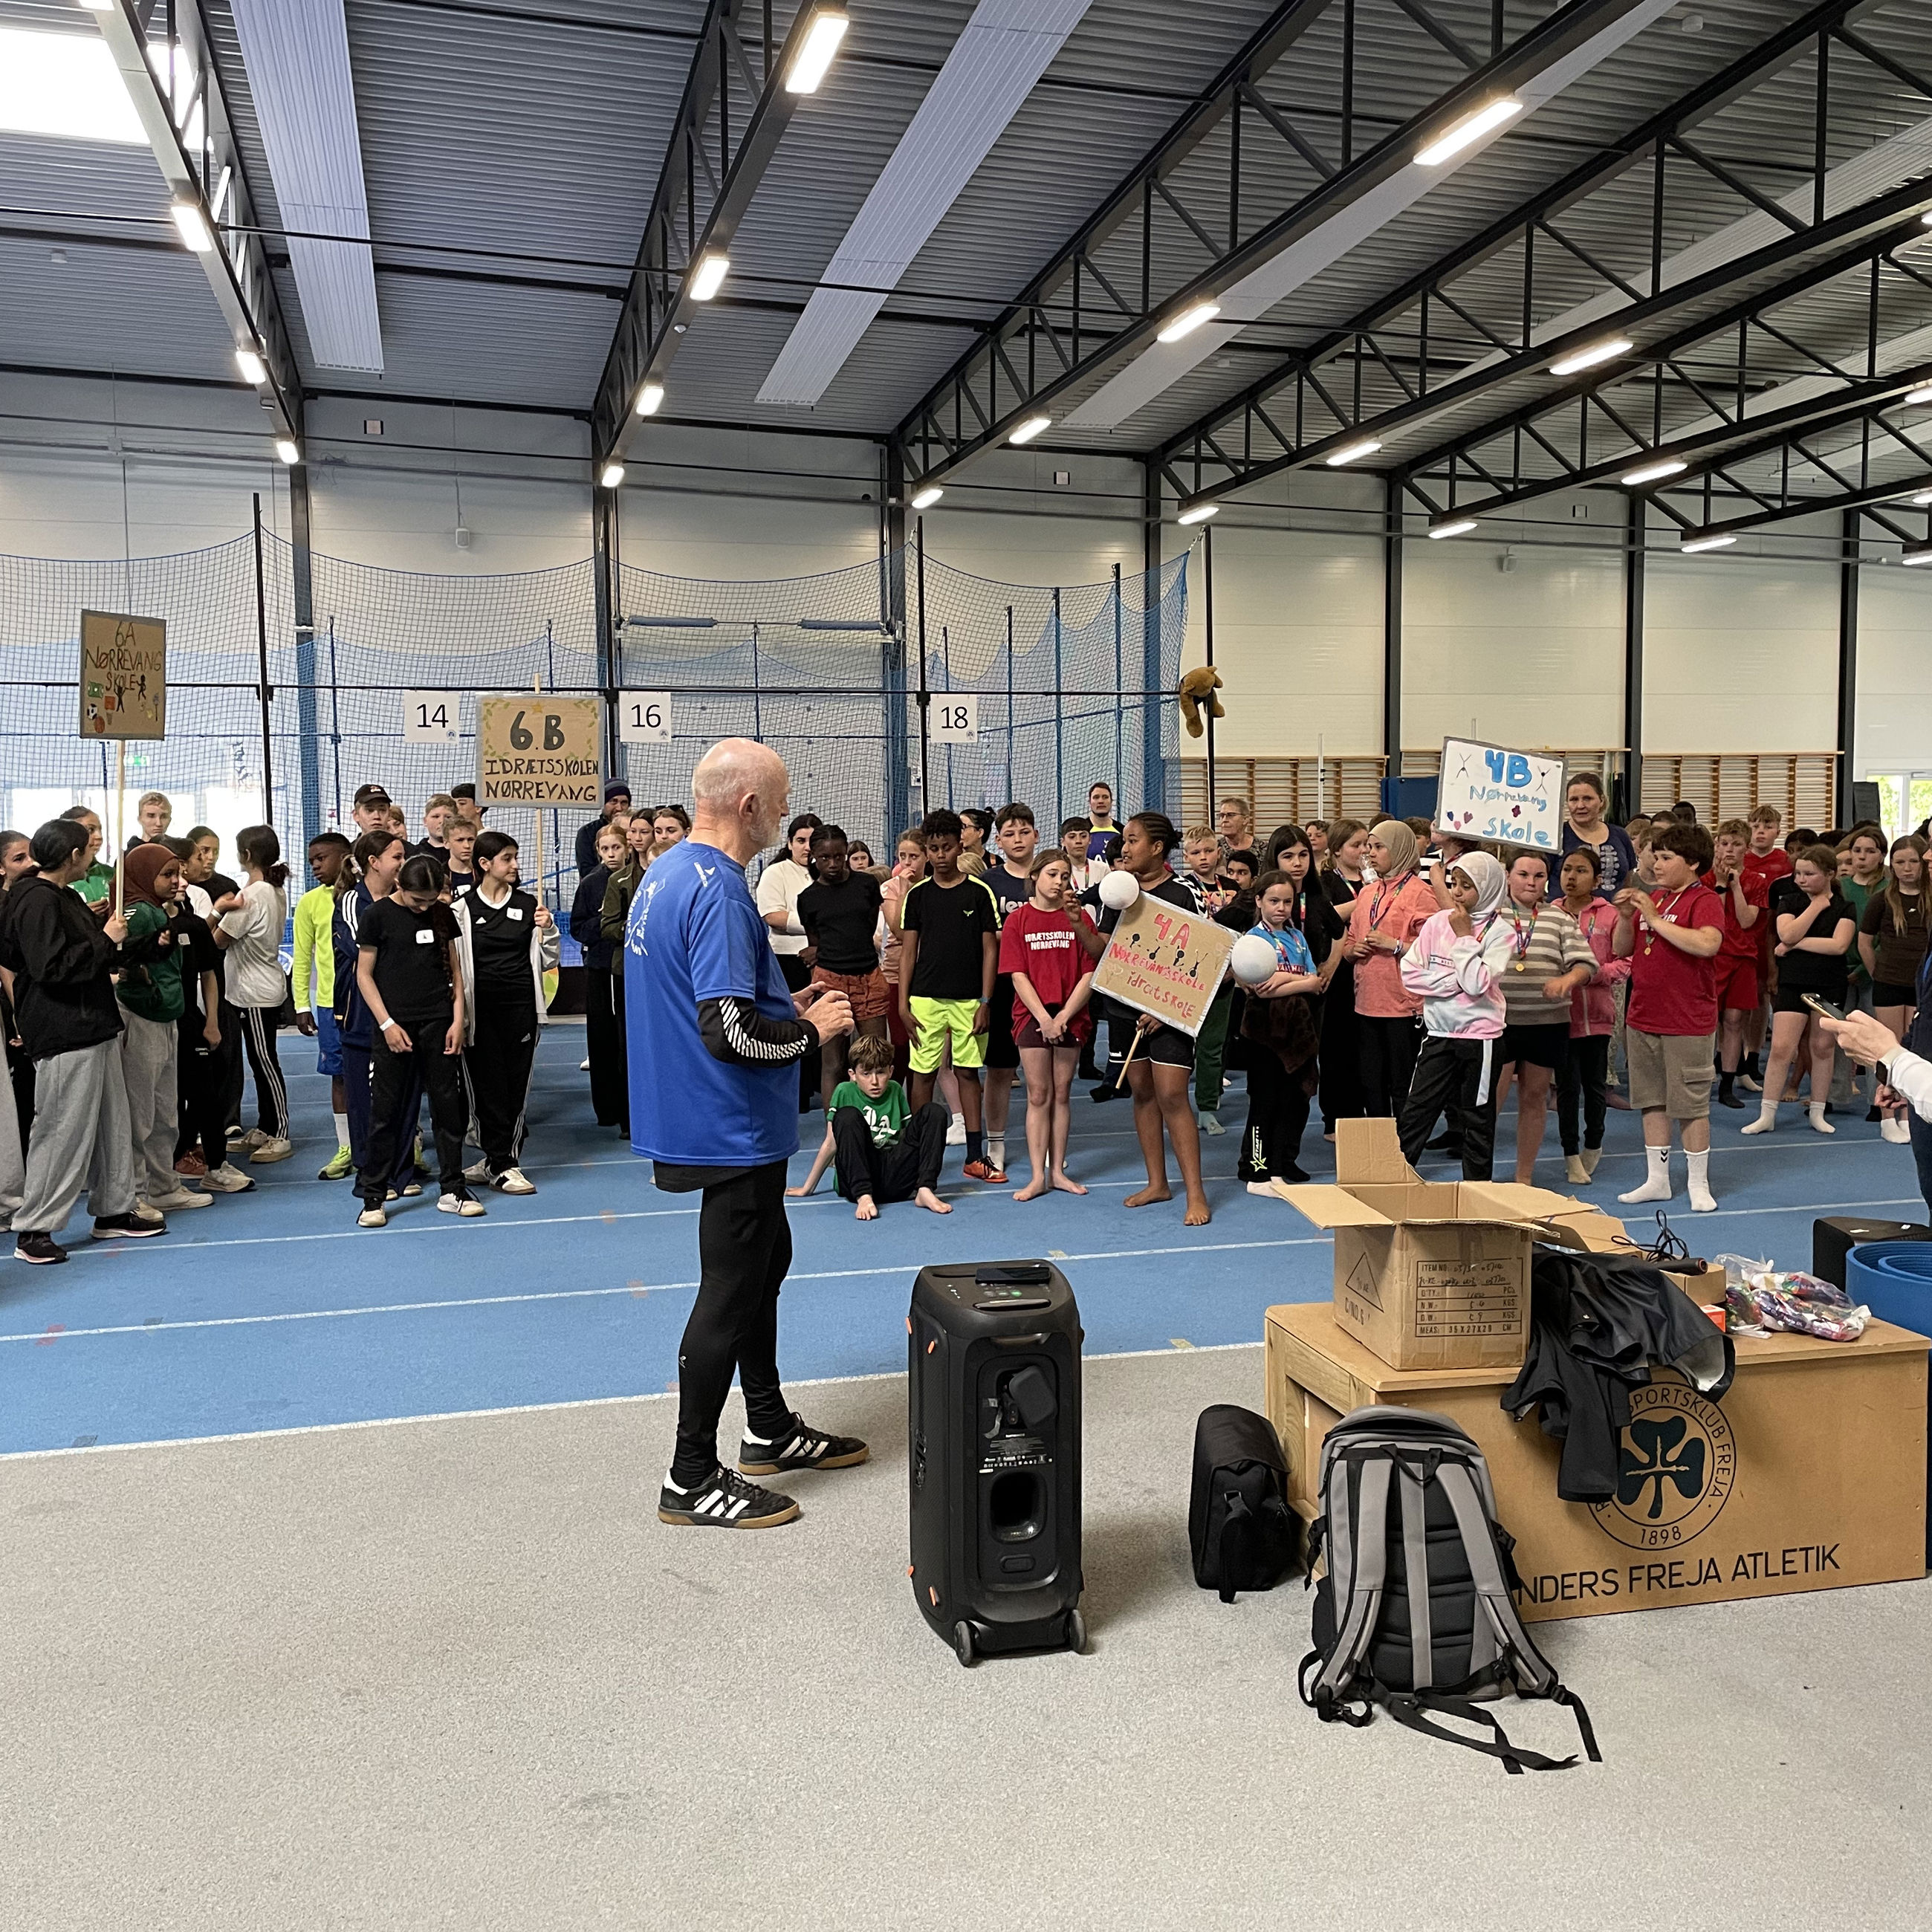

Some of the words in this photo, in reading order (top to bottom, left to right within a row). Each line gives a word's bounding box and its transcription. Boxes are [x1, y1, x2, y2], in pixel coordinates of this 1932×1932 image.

[114, 621, 136, 647] 6A
[85, 646, 163, 672] NØRREVANG
[105, 671, 136, 692] SKOLE
[416, 704, 449, 729] 14
[631, 704, 661, 728] 16
[941, 707, 969, 729] 18
[485, 758, 599, 777] IDRÆTSSKOLEN
[485, 781, 597, 802] NØRREVANG
[1482, 817, 1552, 846] Skole
[1709, 1443, 1731, 1497] FREJA
[1641, 1526, 1682, 1546] 1898
[1628, 1557, 1722, 1593] FREJA
[1731, 1543, 1841, 1581] ATLETIK
